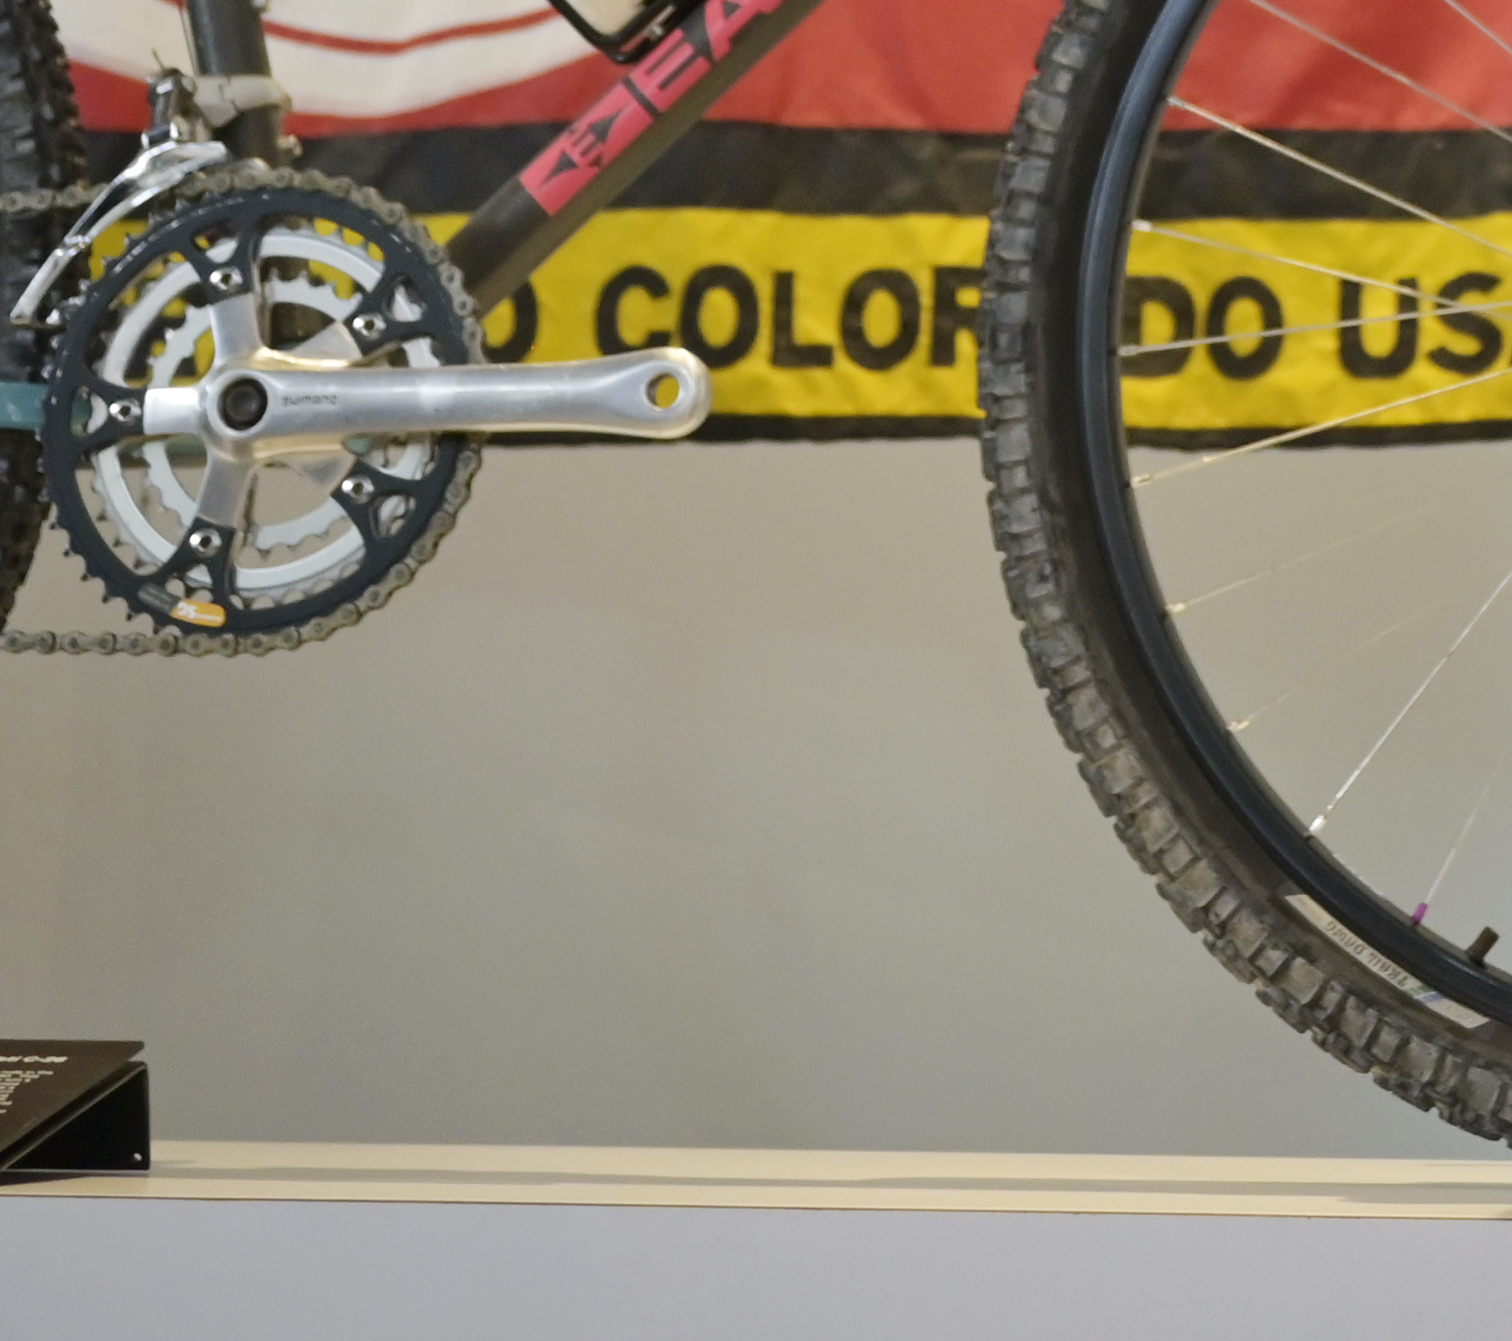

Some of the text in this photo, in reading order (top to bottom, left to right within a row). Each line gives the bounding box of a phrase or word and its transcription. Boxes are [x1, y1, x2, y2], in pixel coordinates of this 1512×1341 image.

[595, 264, 1284, 380] COLORDO
[1325, 920, 1409, 987] TRAIL DAWG
